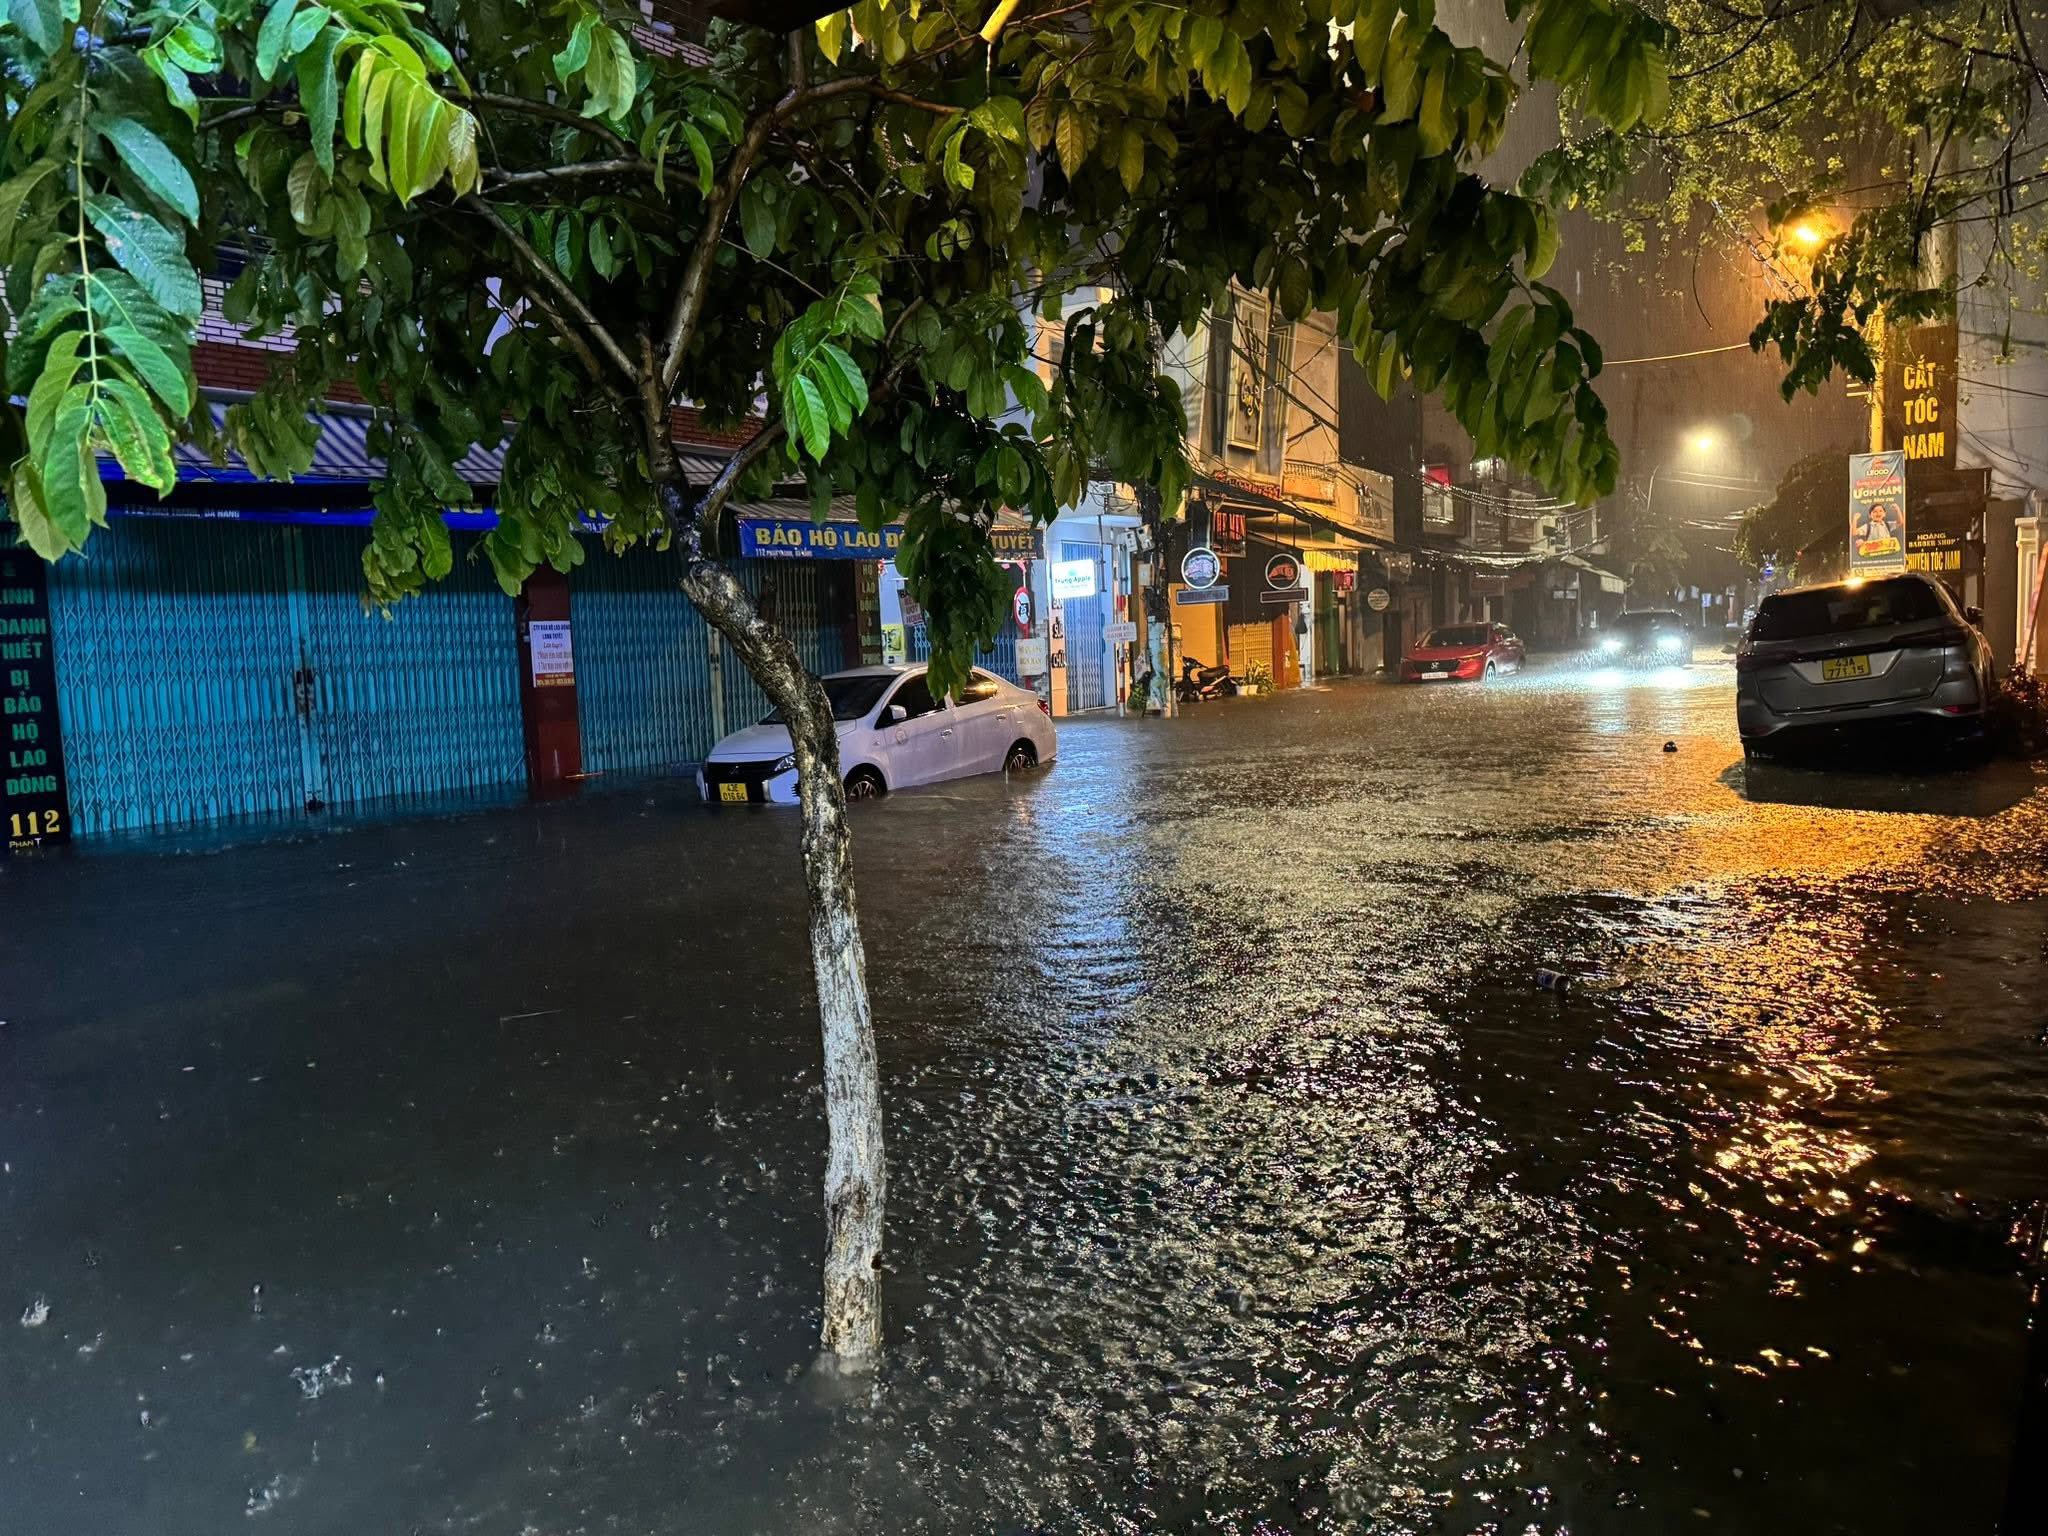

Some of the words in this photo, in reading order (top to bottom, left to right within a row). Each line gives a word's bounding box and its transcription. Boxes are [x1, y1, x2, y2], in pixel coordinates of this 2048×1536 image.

[1904, 354, 1936, 389] CẮT
[1903, 394, 1938, 425] TÓC
[1903, 432, 1945, 460] NAM
[755, 523, 802, 546] BẢO
[809, 527, 838, 549] HỘ
[844, 532, 880, 547] LAO
[992, 531, 1034, 549] TUYẾT
[1931, 547, 1944, 571] TÓC
[1945, 550, 1961, 570] NAM
[10, 669, 29, 690] BỊ
[3, 690, 42, 714] BẢO
[11, 718, 39, 743] HỘ
[9, 749, 47, 768] LAO
[10, 809, 60, 837] 112
[8, 840, 34, 849] PHAN
